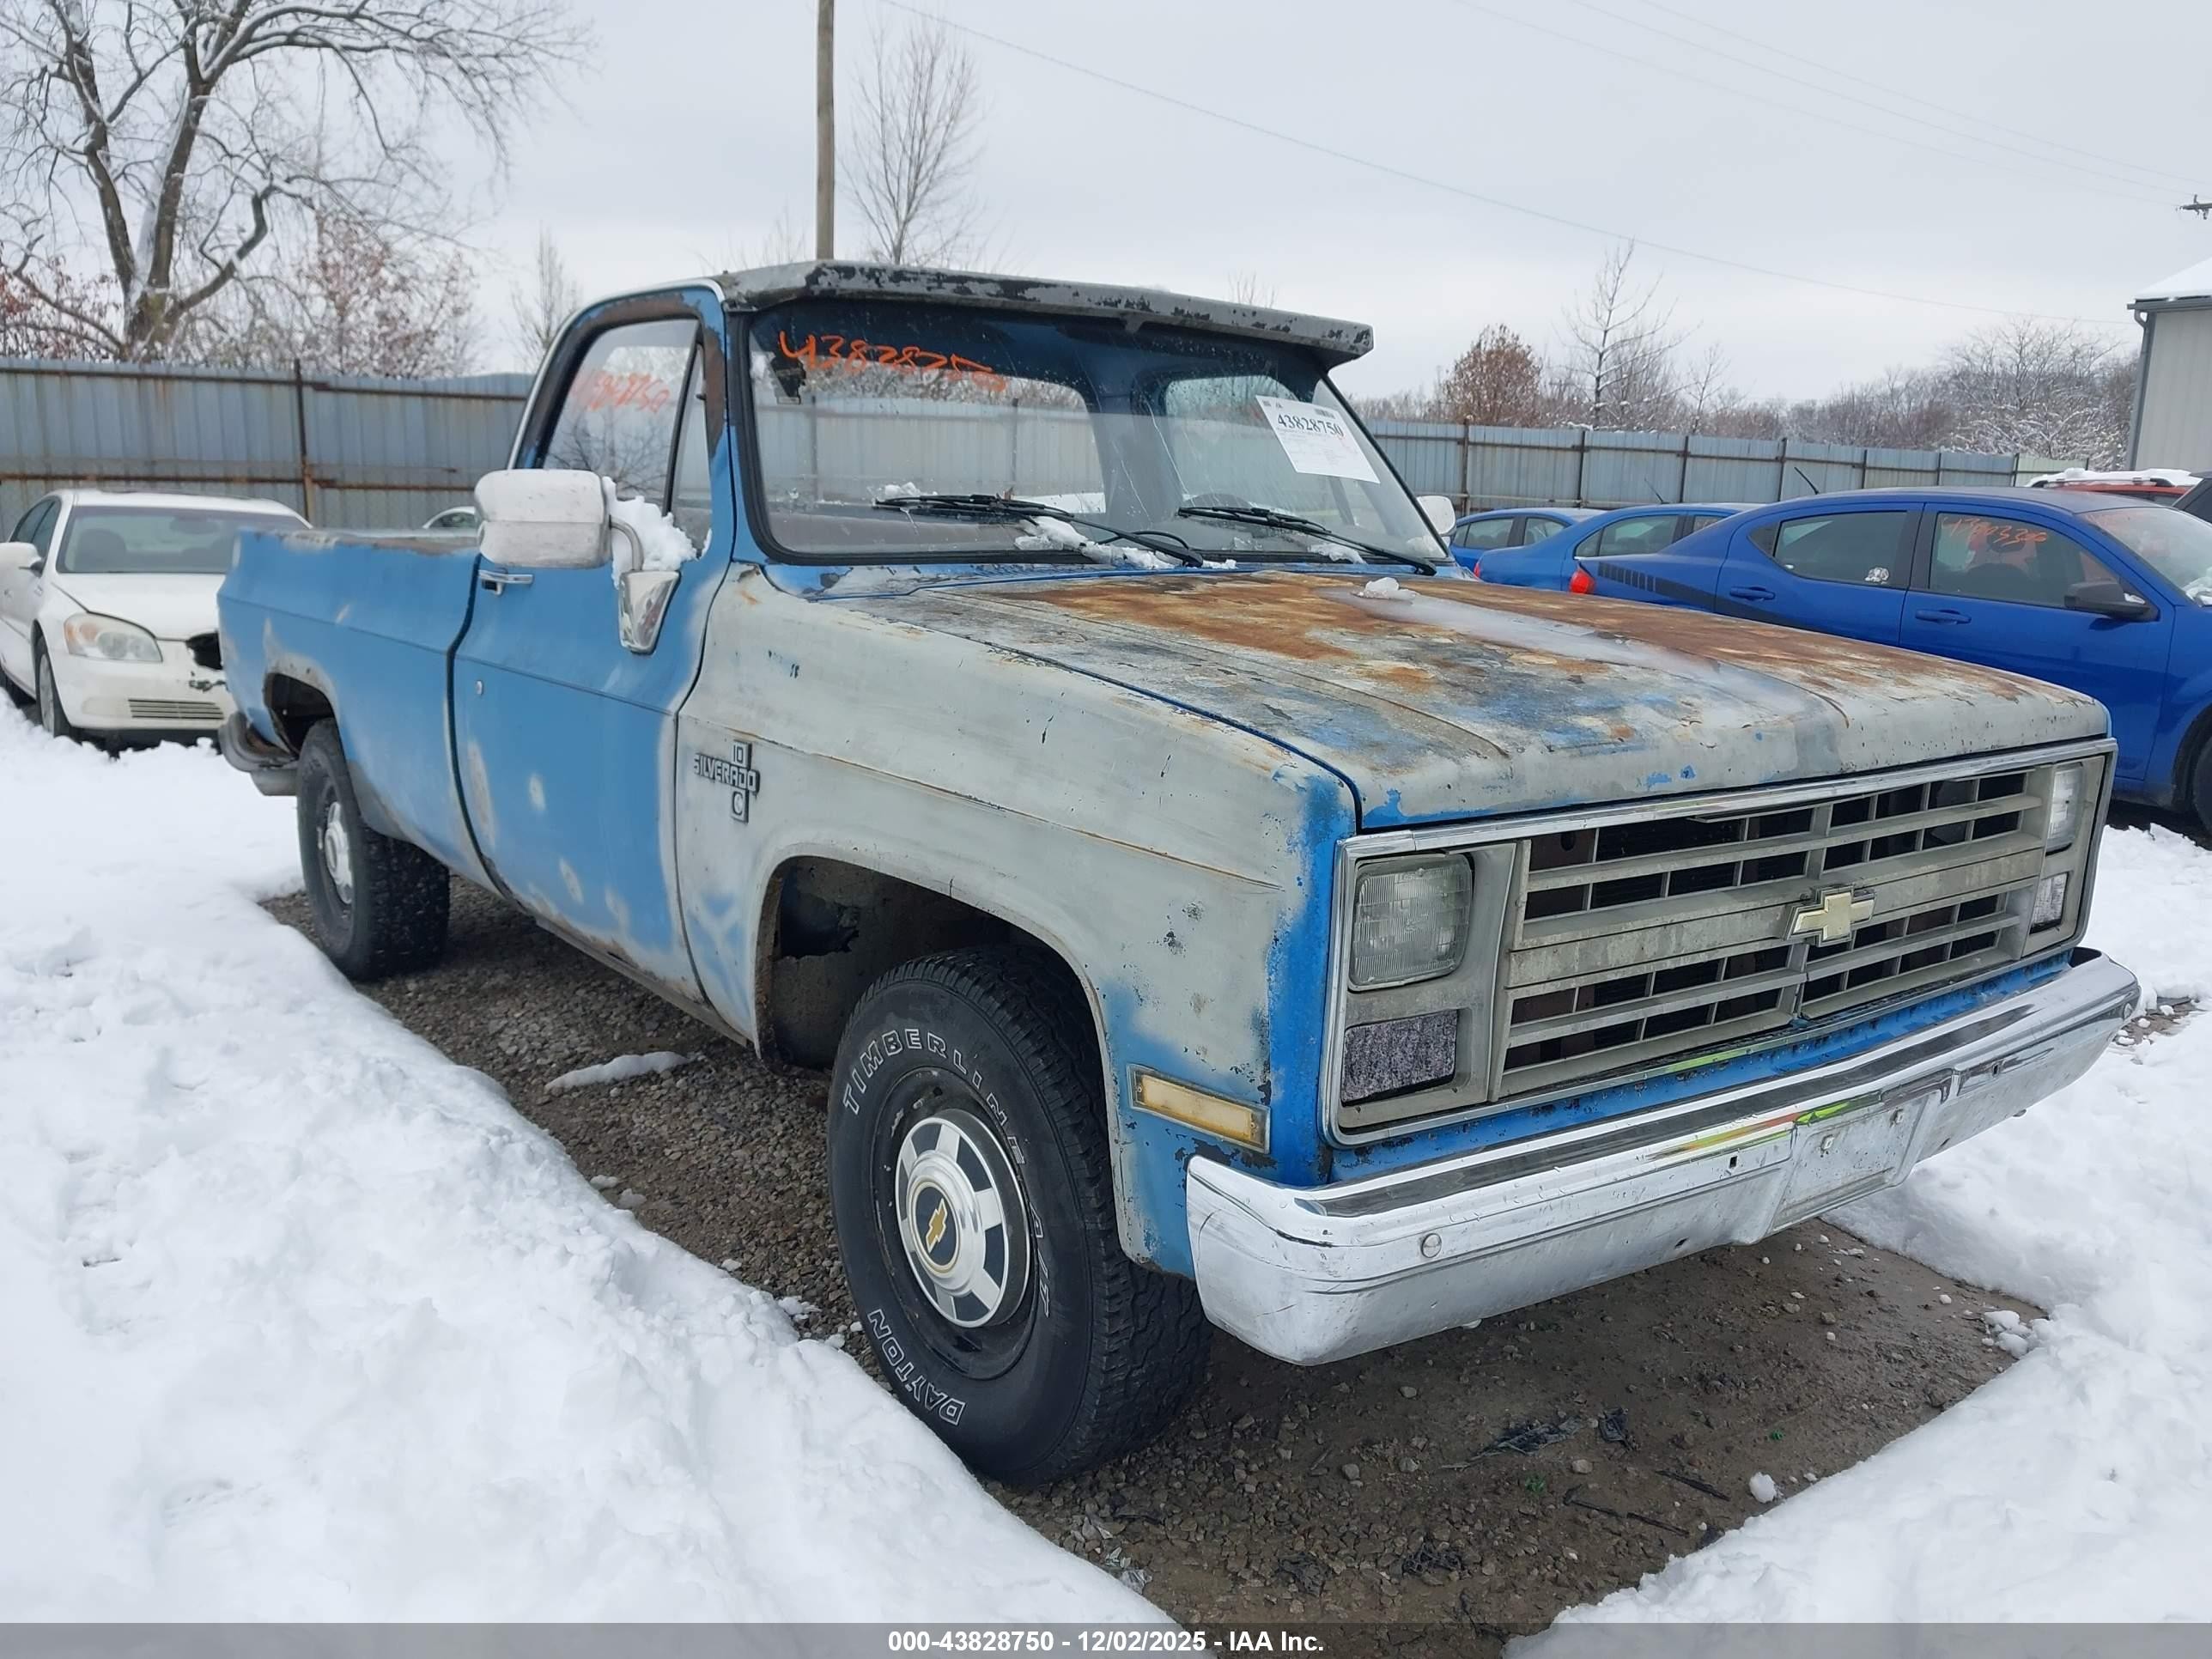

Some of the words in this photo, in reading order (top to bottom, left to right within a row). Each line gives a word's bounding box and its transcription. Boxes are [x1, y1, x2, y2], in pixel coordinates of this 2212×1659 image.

[1278, 414, 1344, 436] 43828750
[694, 753, 757, 793] SILVERADO
[843, 1029, 1024, 1164] TIMBERLINE
[867, 1309, 966, 1426] DAYTON
